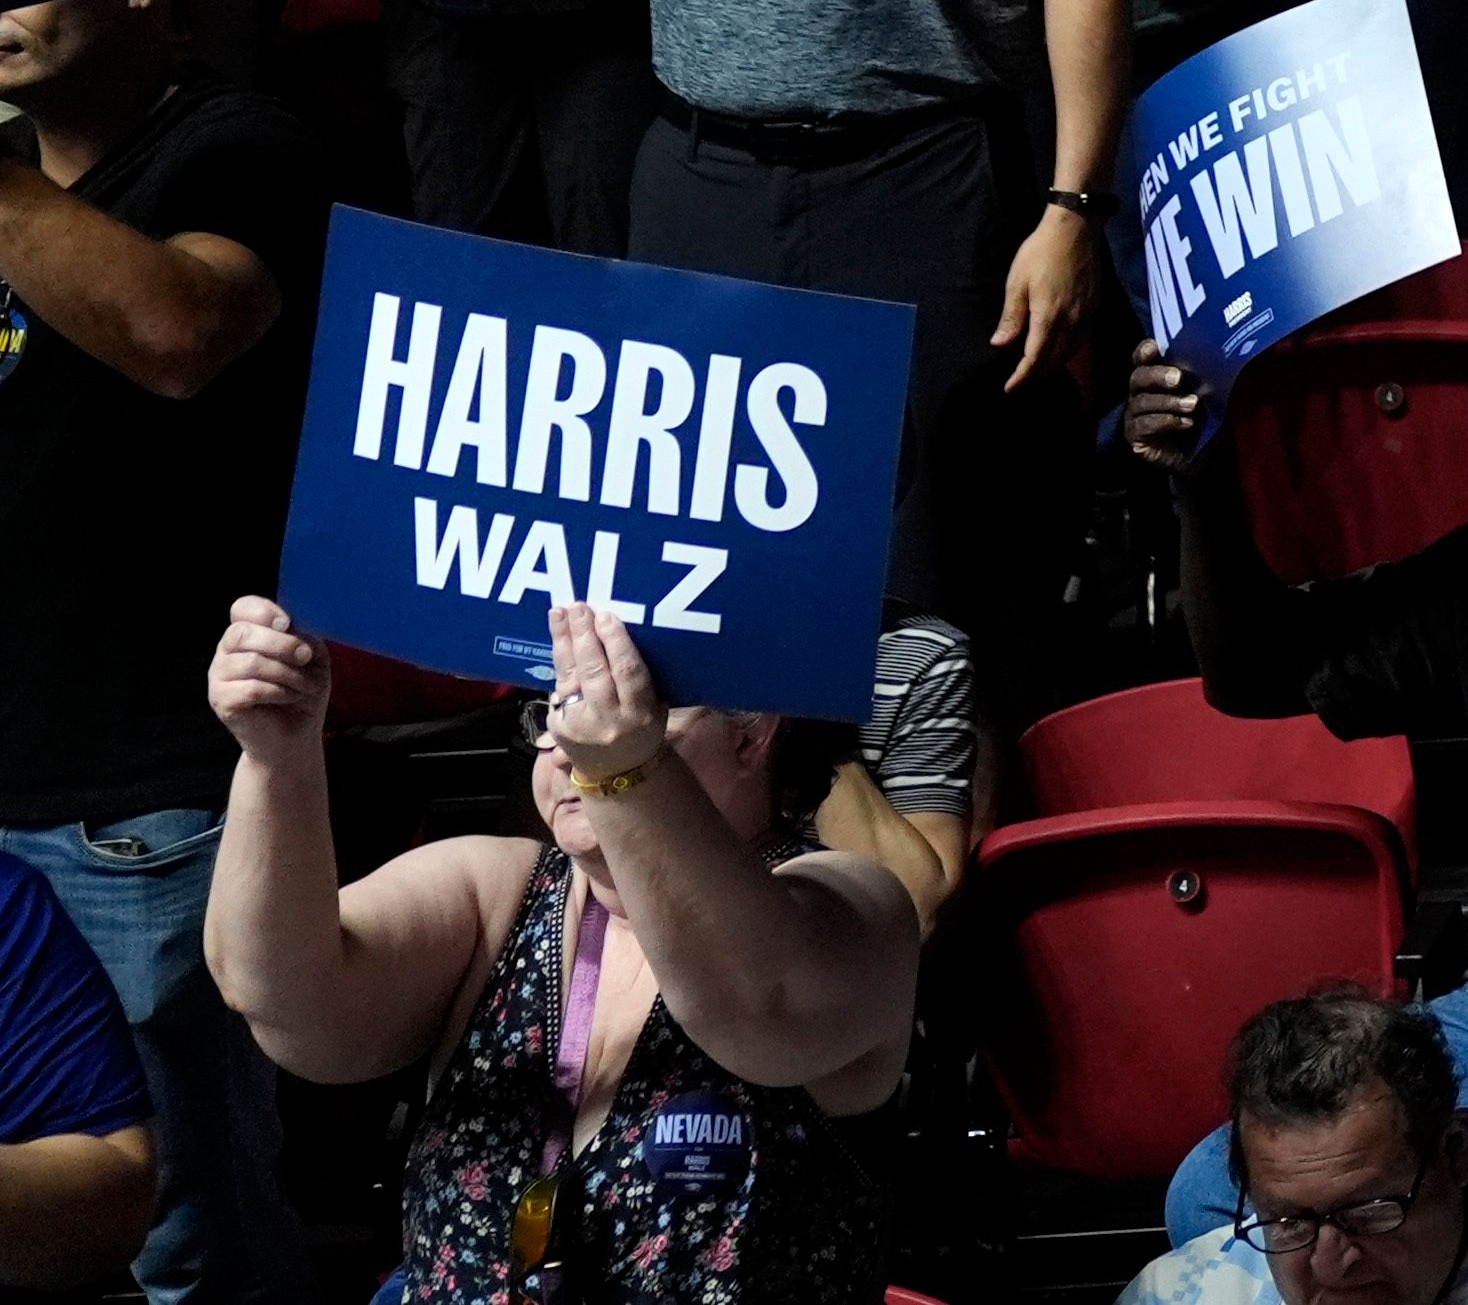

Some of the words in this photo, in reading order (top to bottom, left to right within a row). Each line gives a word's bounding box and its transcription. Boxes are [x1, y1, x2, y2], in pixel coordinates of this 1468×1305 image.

[1168, 110, 1223, 172] WE
[1190, 94, 1379, 280] WIN
[353, 291, 828, 533] HARRIS
[412, 497, 729, 634] WALZ
[1178, 879, 1188, 893] 4
[655, 1114, 742, 1145] NEVADA
